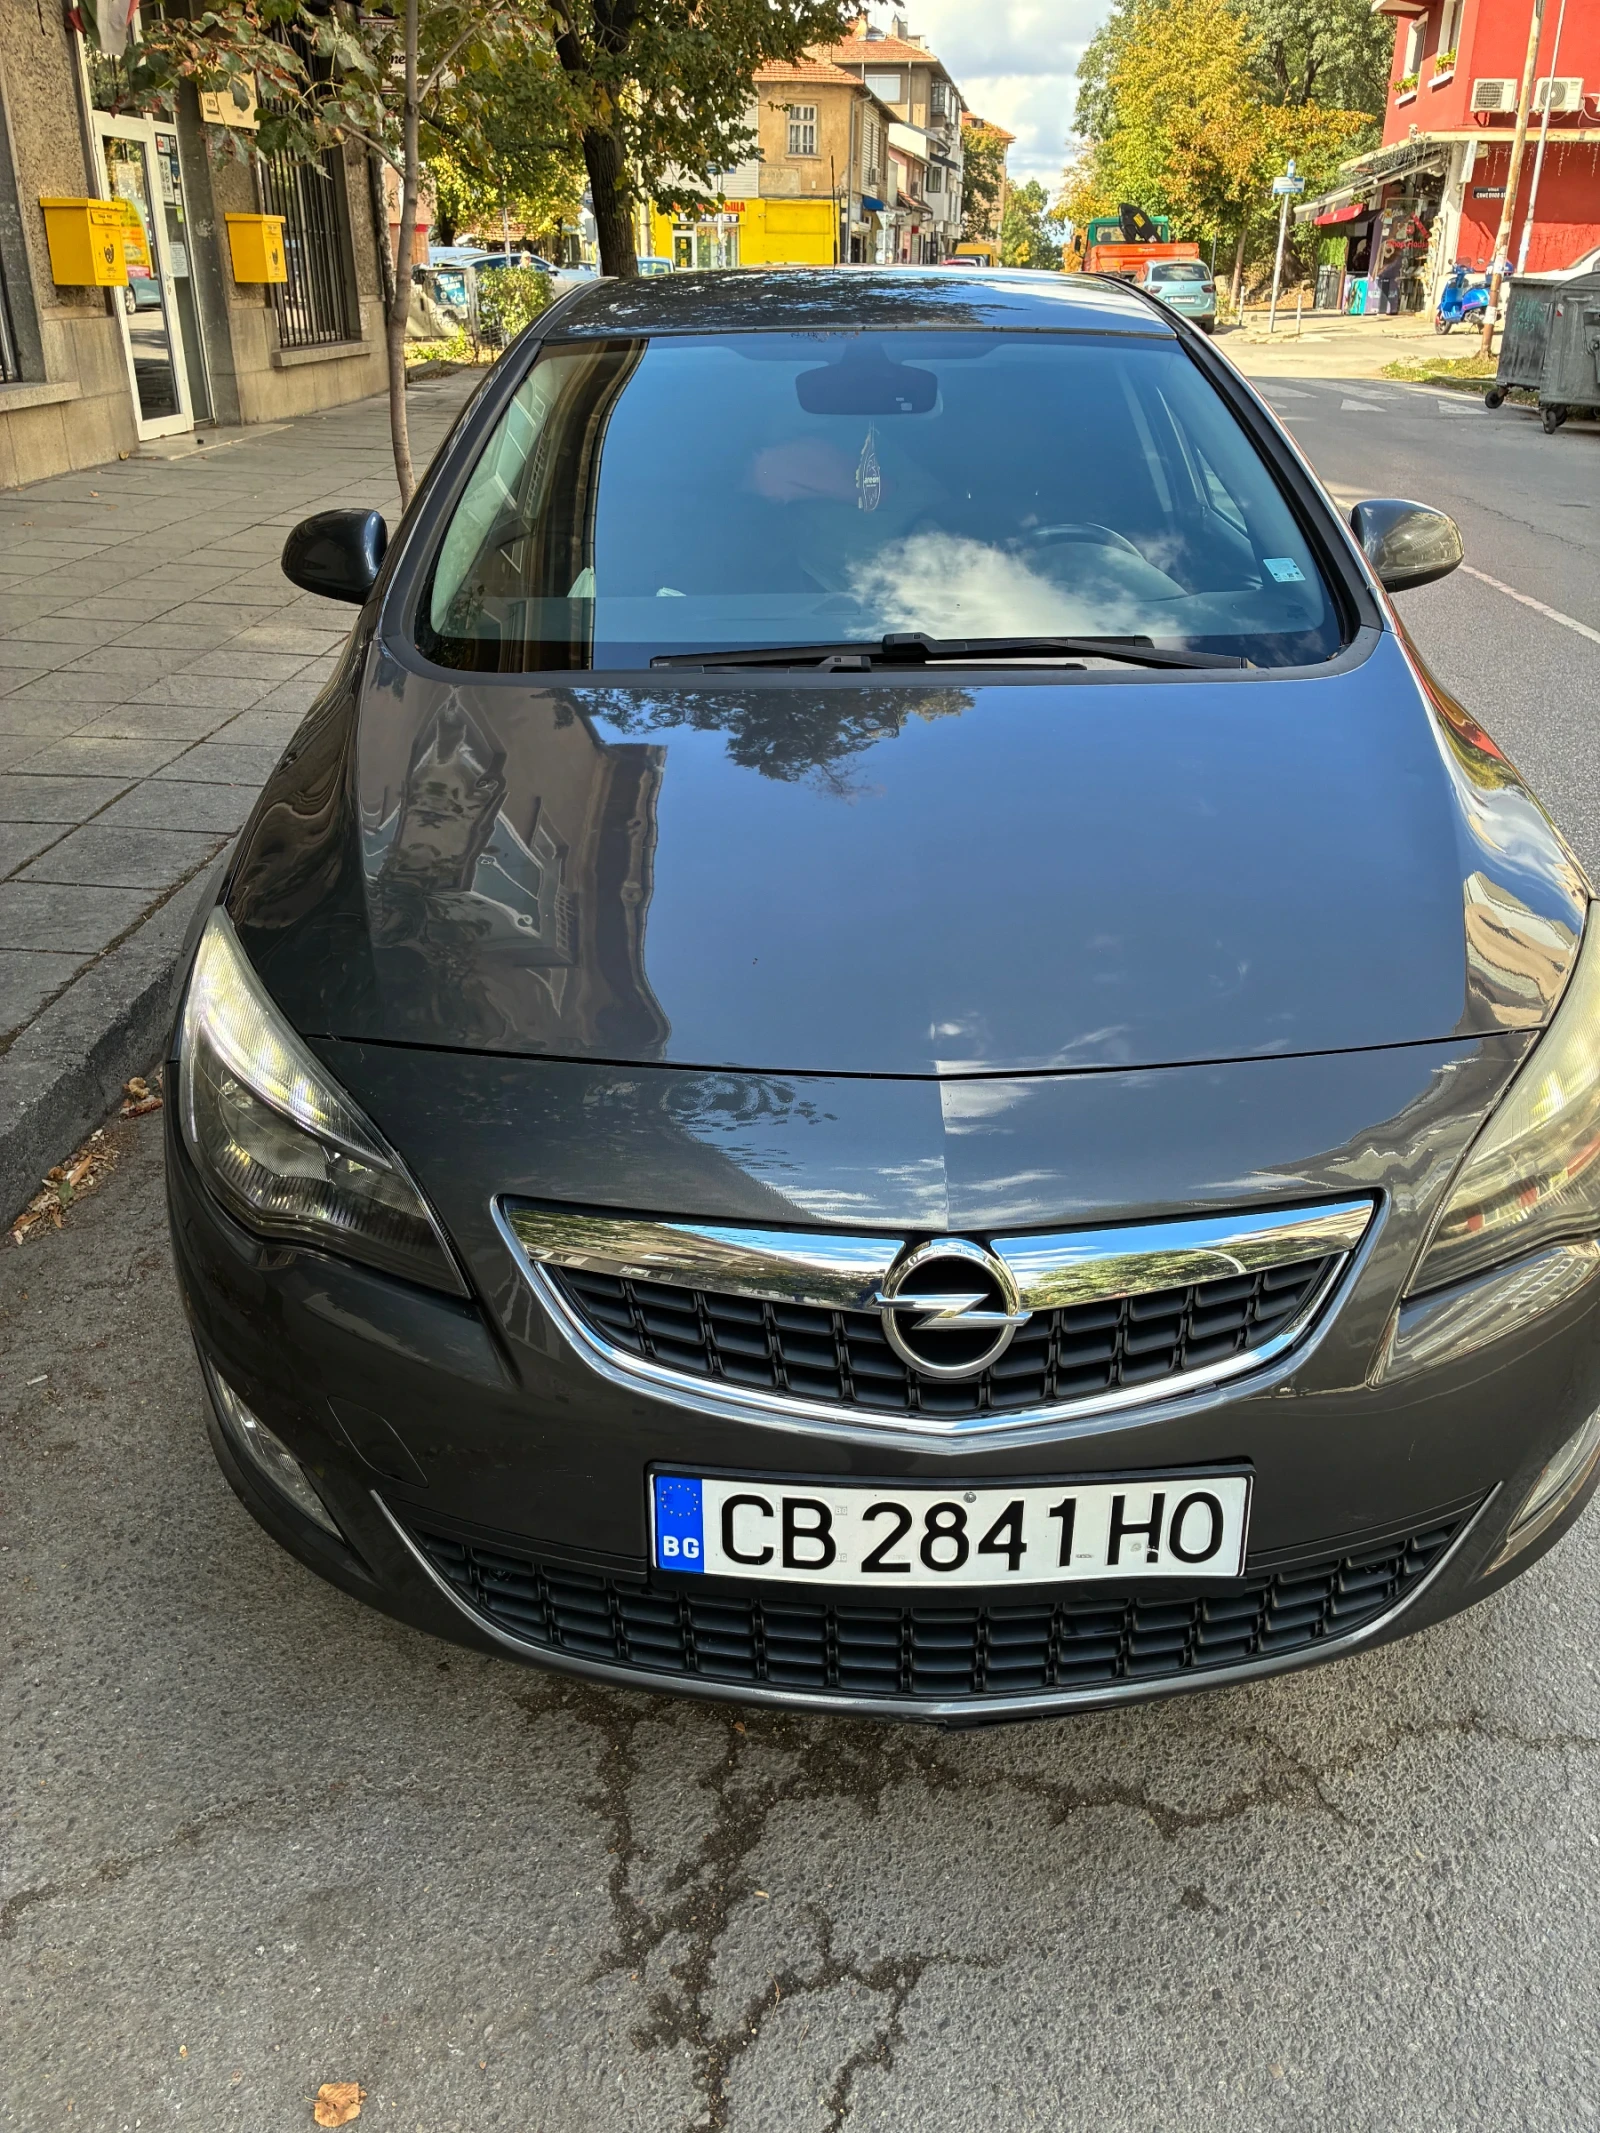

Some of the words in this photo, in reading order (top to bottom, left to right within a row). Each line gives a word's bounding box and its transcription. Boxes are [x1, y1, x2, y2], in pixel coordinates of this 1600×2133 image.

[724, 202, 746, 212] ЪЩА
[721, 1493, 836, 1570] CB
[861, 1500, 1077, 1573] 2841
[1108, 1492, 1224, 1566] HO
[662, 1536, 700, 1559] BG
